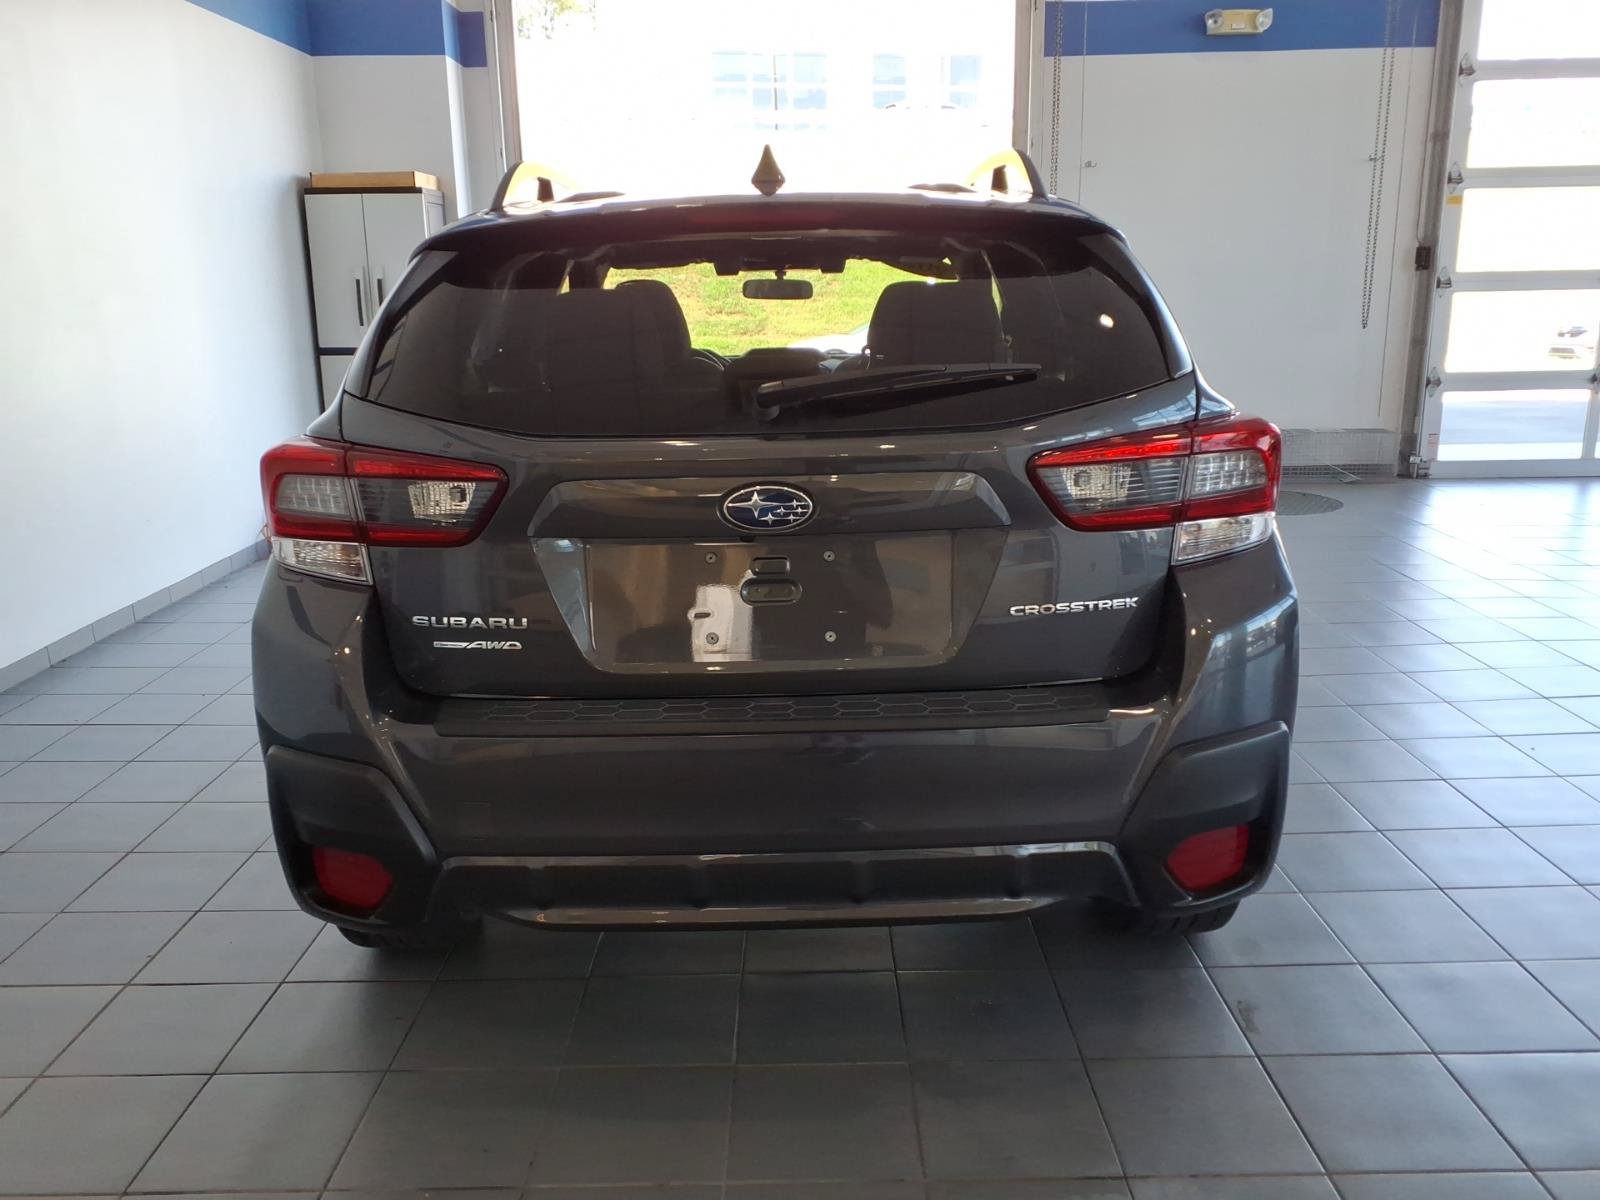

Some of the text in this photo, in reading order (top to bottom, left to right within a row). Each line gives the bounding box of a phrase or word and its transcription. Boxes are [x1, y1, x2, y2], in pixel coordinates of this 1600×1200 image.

[1009, 596, 1139, 616] CROSSTREK
[412, 615, 528, 630] SUBARU
[465, 640, 522, 650] AWD
